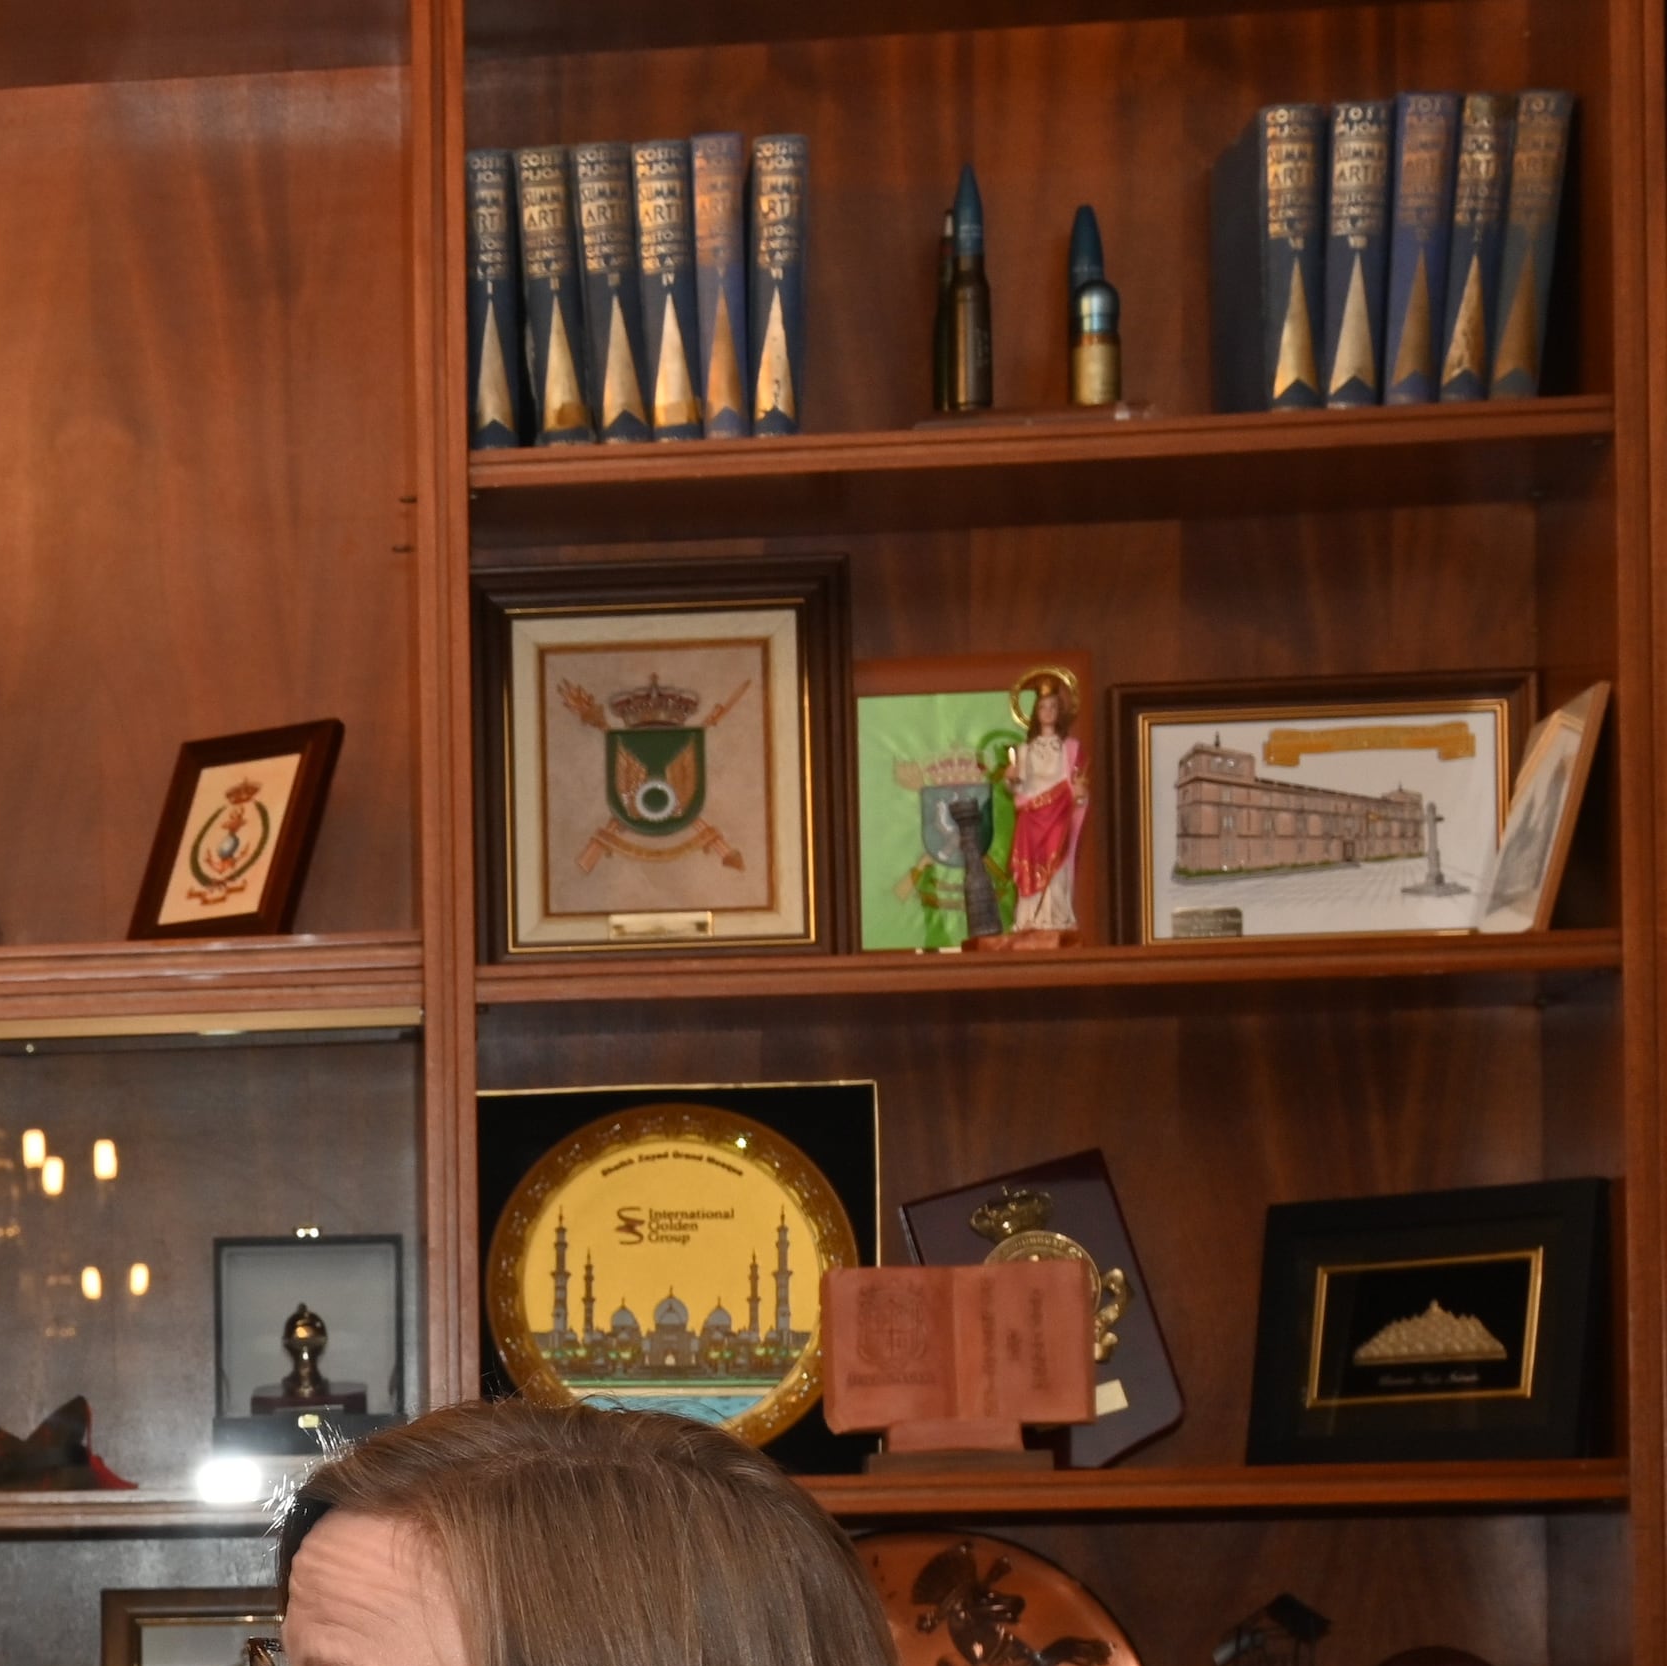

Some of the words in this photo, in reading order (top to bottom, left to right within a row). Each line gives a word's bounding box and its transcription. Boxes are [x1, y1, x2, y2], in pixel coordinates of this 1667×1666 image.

[648, 1207, 735, 1221] International
[647, 1219, 699, 1232] Golden
[647, 1231, 691, 1245] Group
